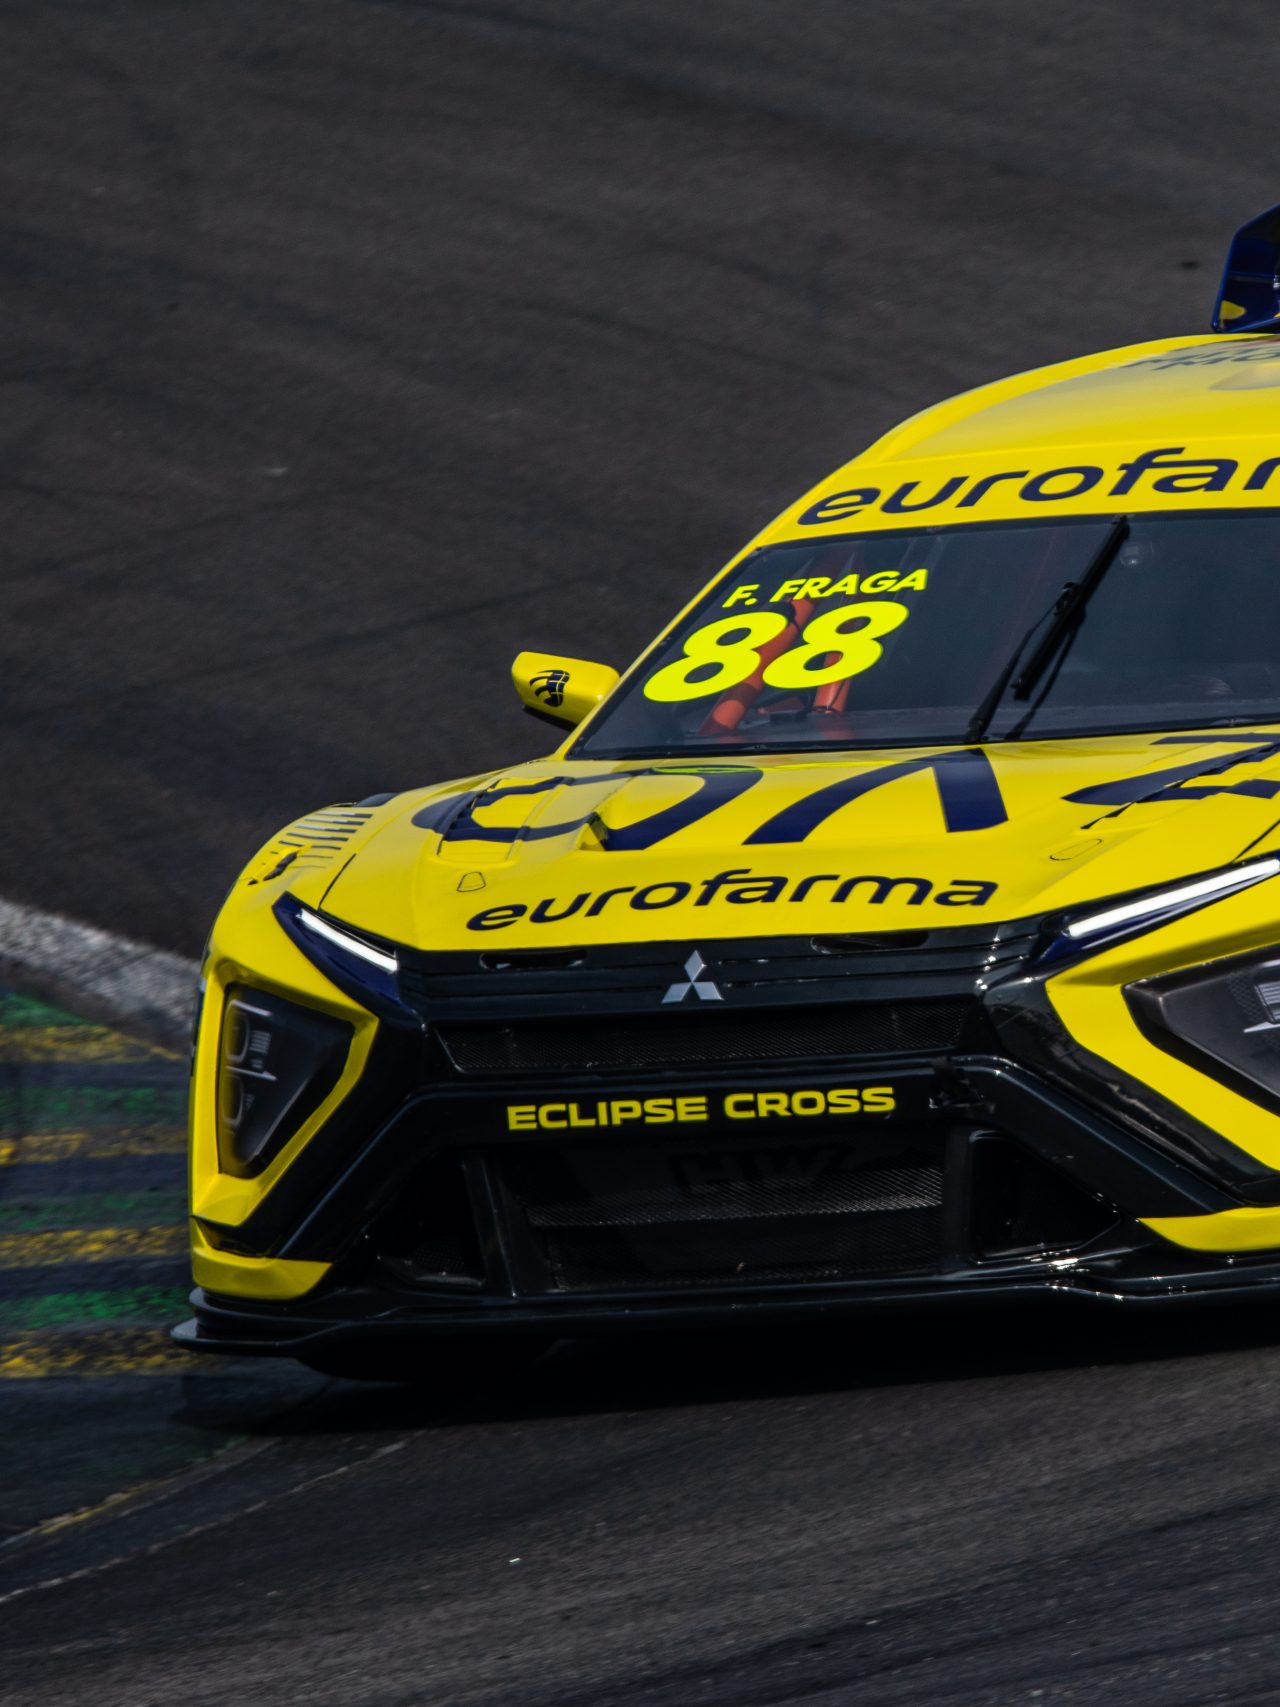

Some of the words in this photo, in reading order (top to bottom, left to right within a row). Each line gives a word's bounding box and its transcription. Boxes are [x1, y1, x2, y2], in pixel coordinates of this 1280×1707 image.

[722, 584, 760, 608] F.
[769, 568, 928, 603] FRAGA
[643, 600, 909, 703] 88
[466, 868, 999, 932] eurofarma
[508, 1097, 707, 1130] ECLIPSE
[725, 1087, 896, 1118] CROSS
